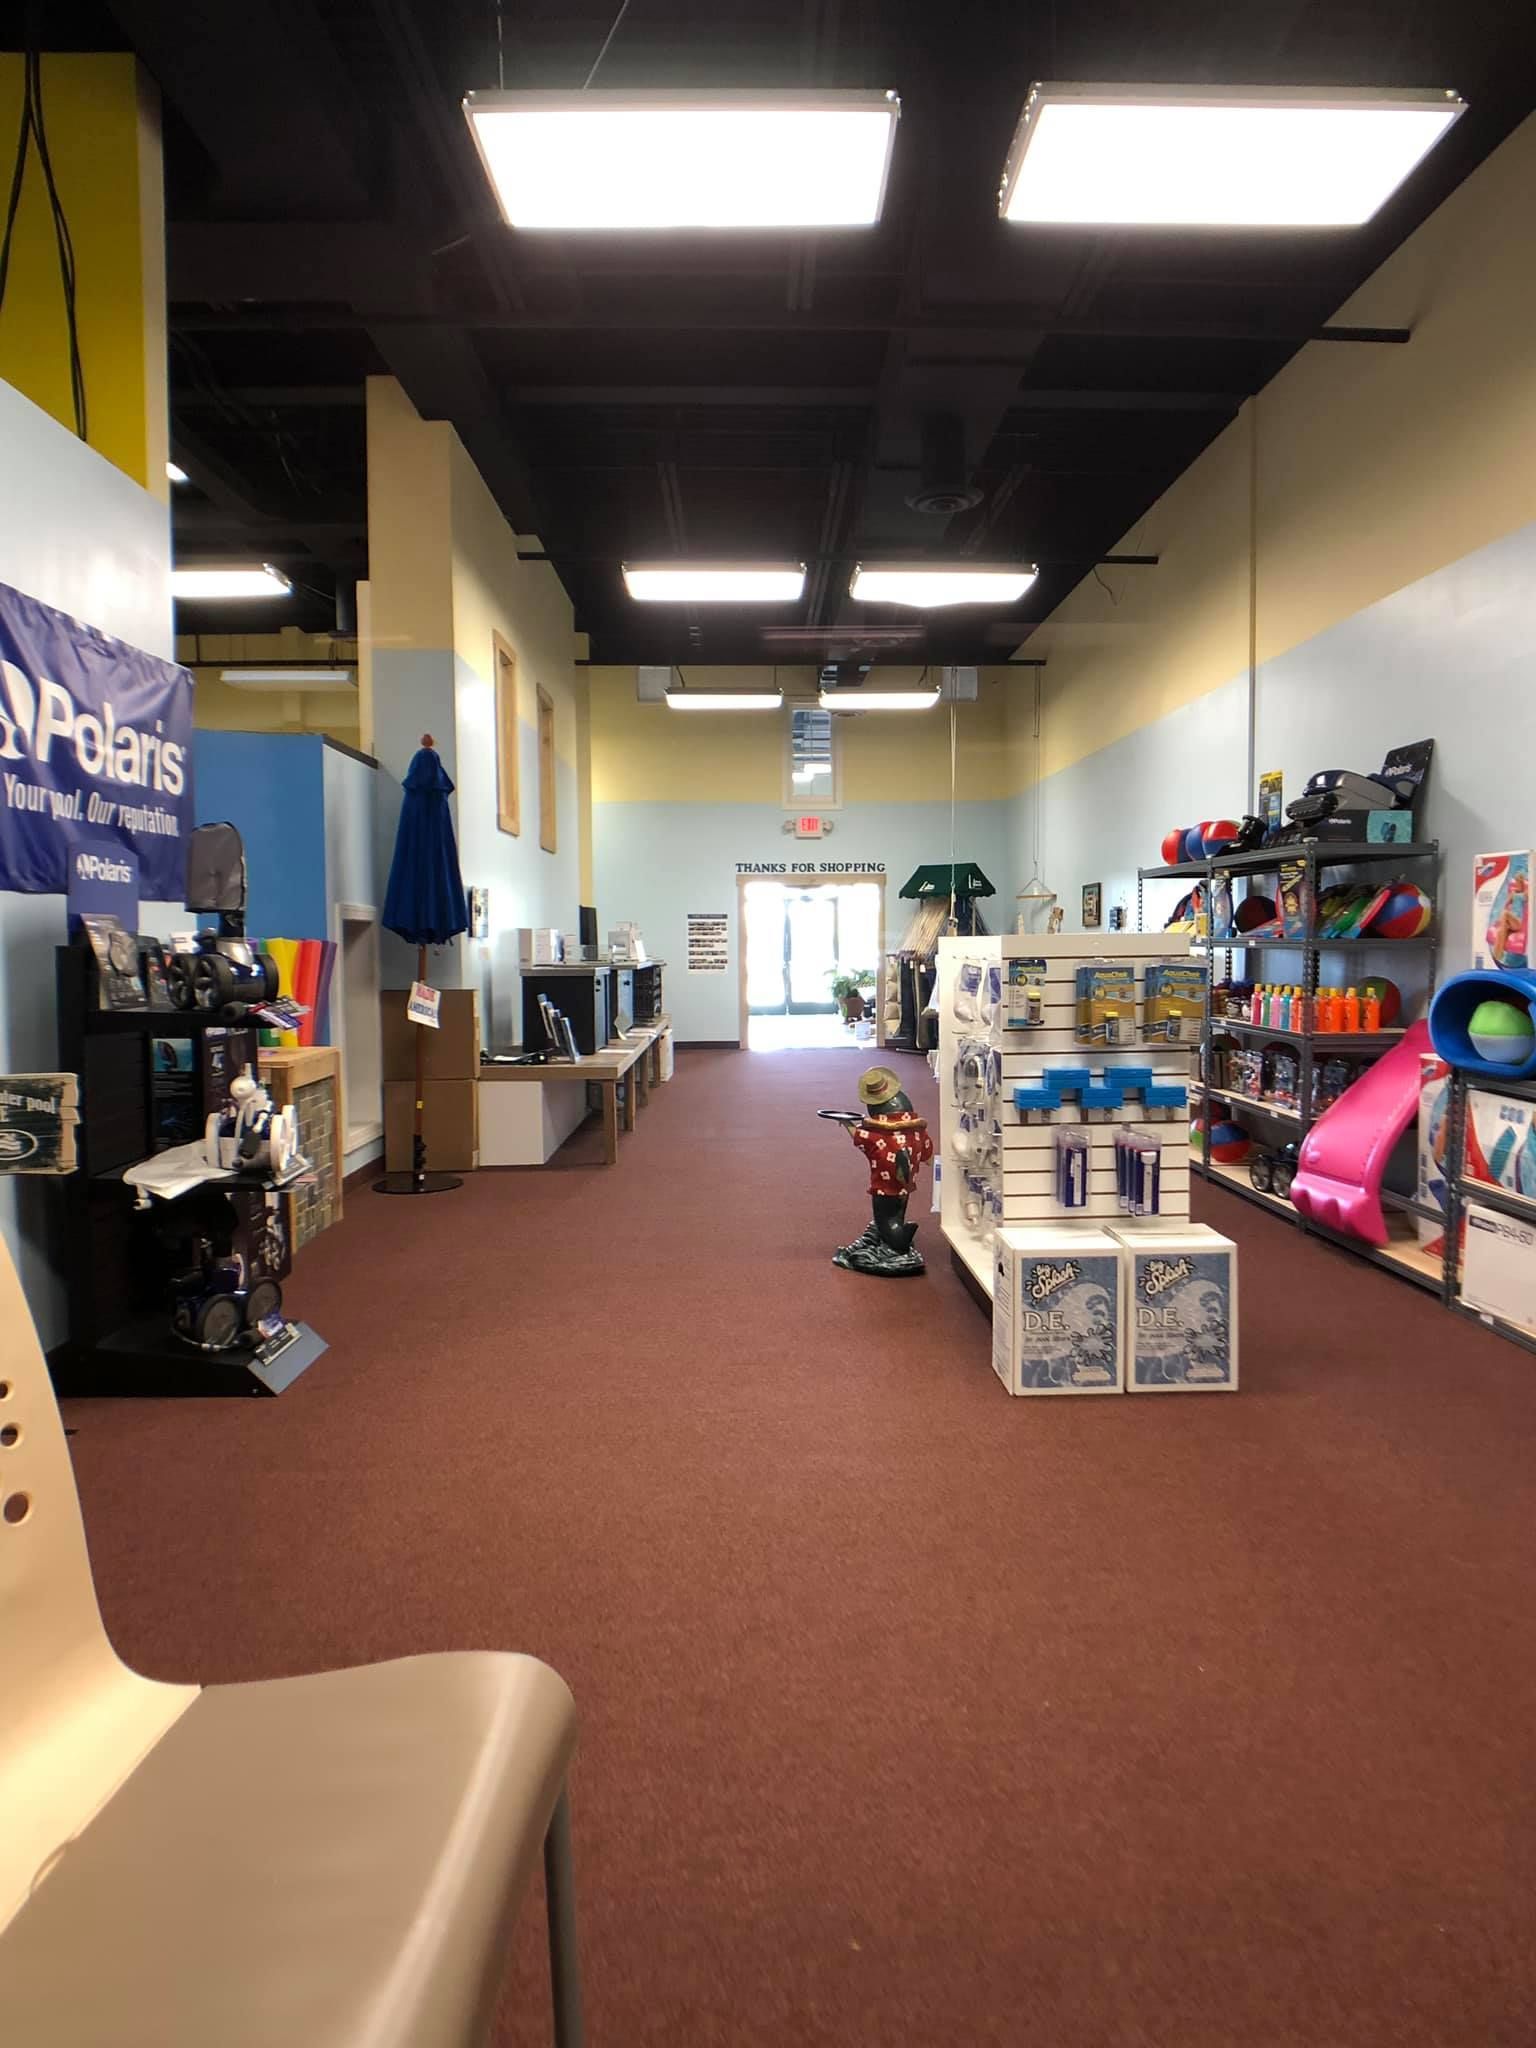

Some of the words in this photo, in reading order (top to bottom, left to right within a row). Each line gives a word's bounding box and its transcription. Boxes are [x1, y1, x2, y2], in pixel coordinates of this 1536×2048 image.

[36, 676, 185, 796] Polaris
[4, 772, 48, 813] Your
[87, 792, 117, 825] Our
[801, 817, 819, 832] EXIT
[90, 855, 132, 883] Polaris
[736, 863, 786, 873] THANKS
[791, 863, 816, 873] FOR
[819, 862, 886, 873] SHOPPING
[1031, 1260, 1076, 1299] Splash
[1023, 1310, 1071, 1332] D.E.
[1136, 1306, 1185, 1329] D.E.
